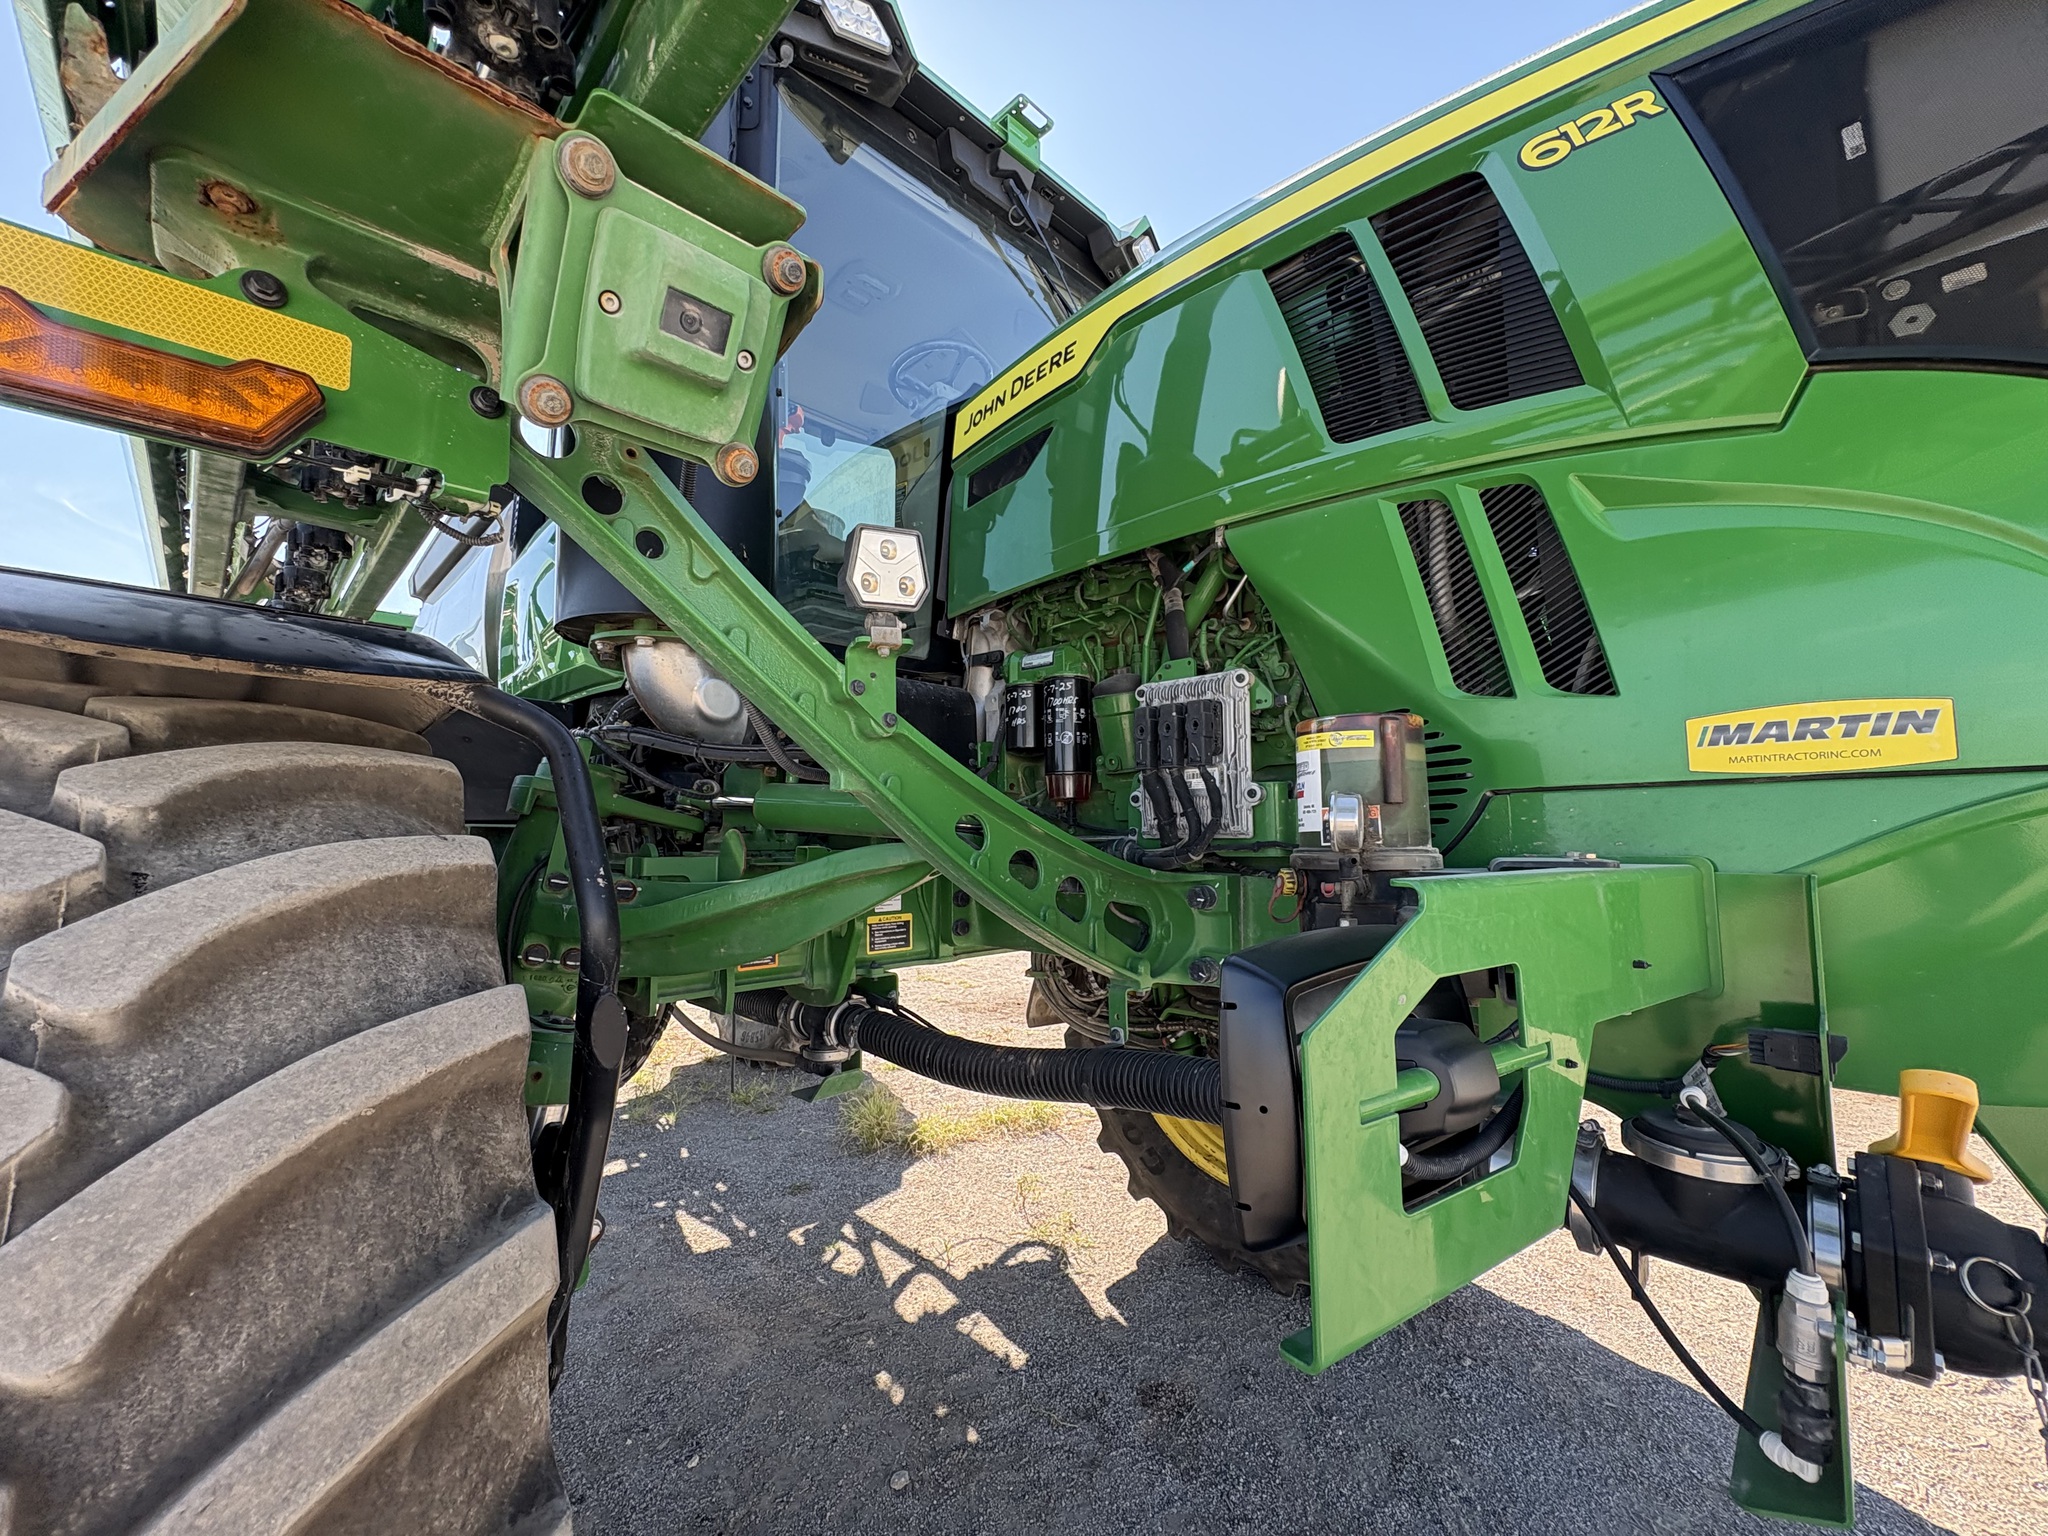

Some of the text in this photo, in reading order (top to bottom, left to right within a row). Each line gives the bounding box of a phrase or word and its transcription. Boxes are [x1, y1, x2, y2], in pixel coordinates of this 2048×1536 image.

[1517, 89, 1668, 171] 612R
[963, 340, 1077, 436] JOHN DEERE
[1706, 708, 1942, 747] MARTIN
[1728, 748, 1882, 764] MARTINTRACTORINC.COM
